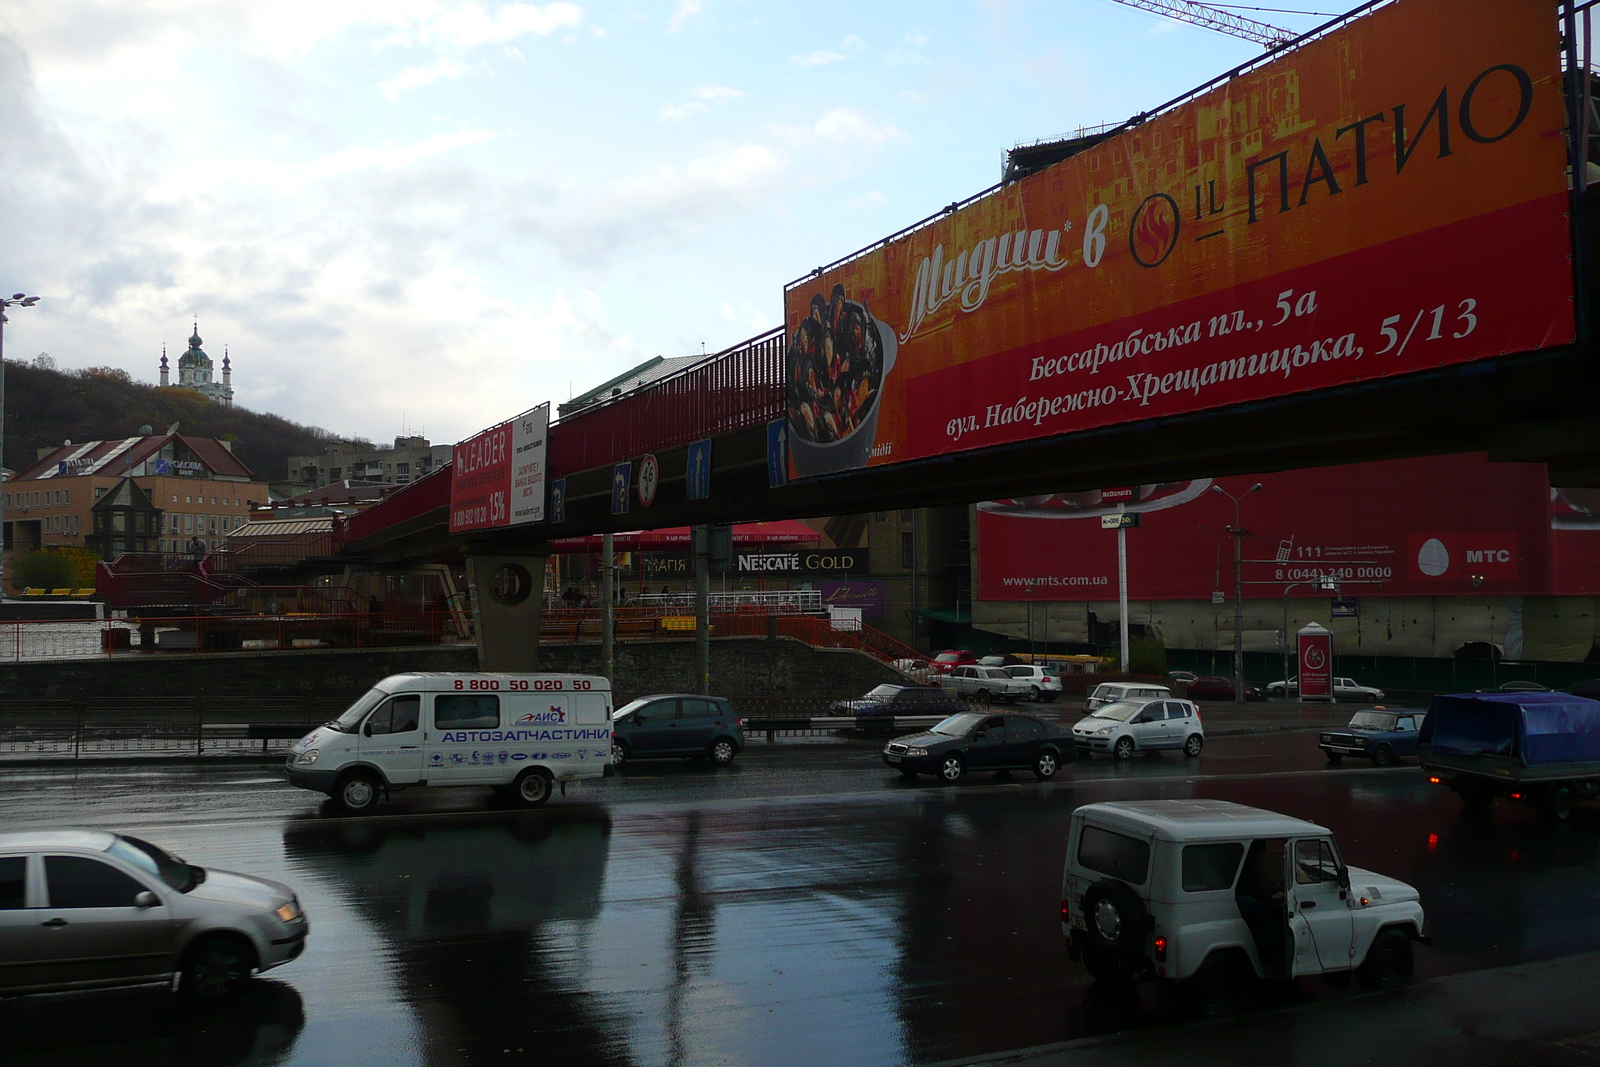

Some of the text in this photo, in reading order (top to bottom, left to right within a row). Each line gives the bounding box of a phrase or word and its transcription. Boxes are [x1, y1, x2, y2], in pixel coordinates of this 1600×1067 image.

[1083, 204, 1108, 268] в
[1194, 179, 1225, 221] IL
[1245, 63, 1533, 226] ПАТИО
[1029, 287, 1317, 381] Бессарабська пл., 5а
[945, 298, 1477, 440] вул. Набережно-Хрещатицька, 5/13
[464, 430, 506, 474] LEADER
[1102, 489, 1132, 498] McDonald's
[1296, 546, 1322, 557] 111
[1466, 550, 1510, 563] МТС
[738, 552, 854, 572] NESCAFÉ GOLD
[1275, 569, 1283, 579] 8
[1287, 568, 1324, 580] (044)
[1357, 566, 1392, 578] 0000
[1003, 574, 1108, 586] www.mts.com.ua
[454, 680, 590, 690] 8 800 50 020 50
[535, 713, 558, 721] АИС
[442, 729, 609, 742] АВТОЗАПЧАСТИНИ
